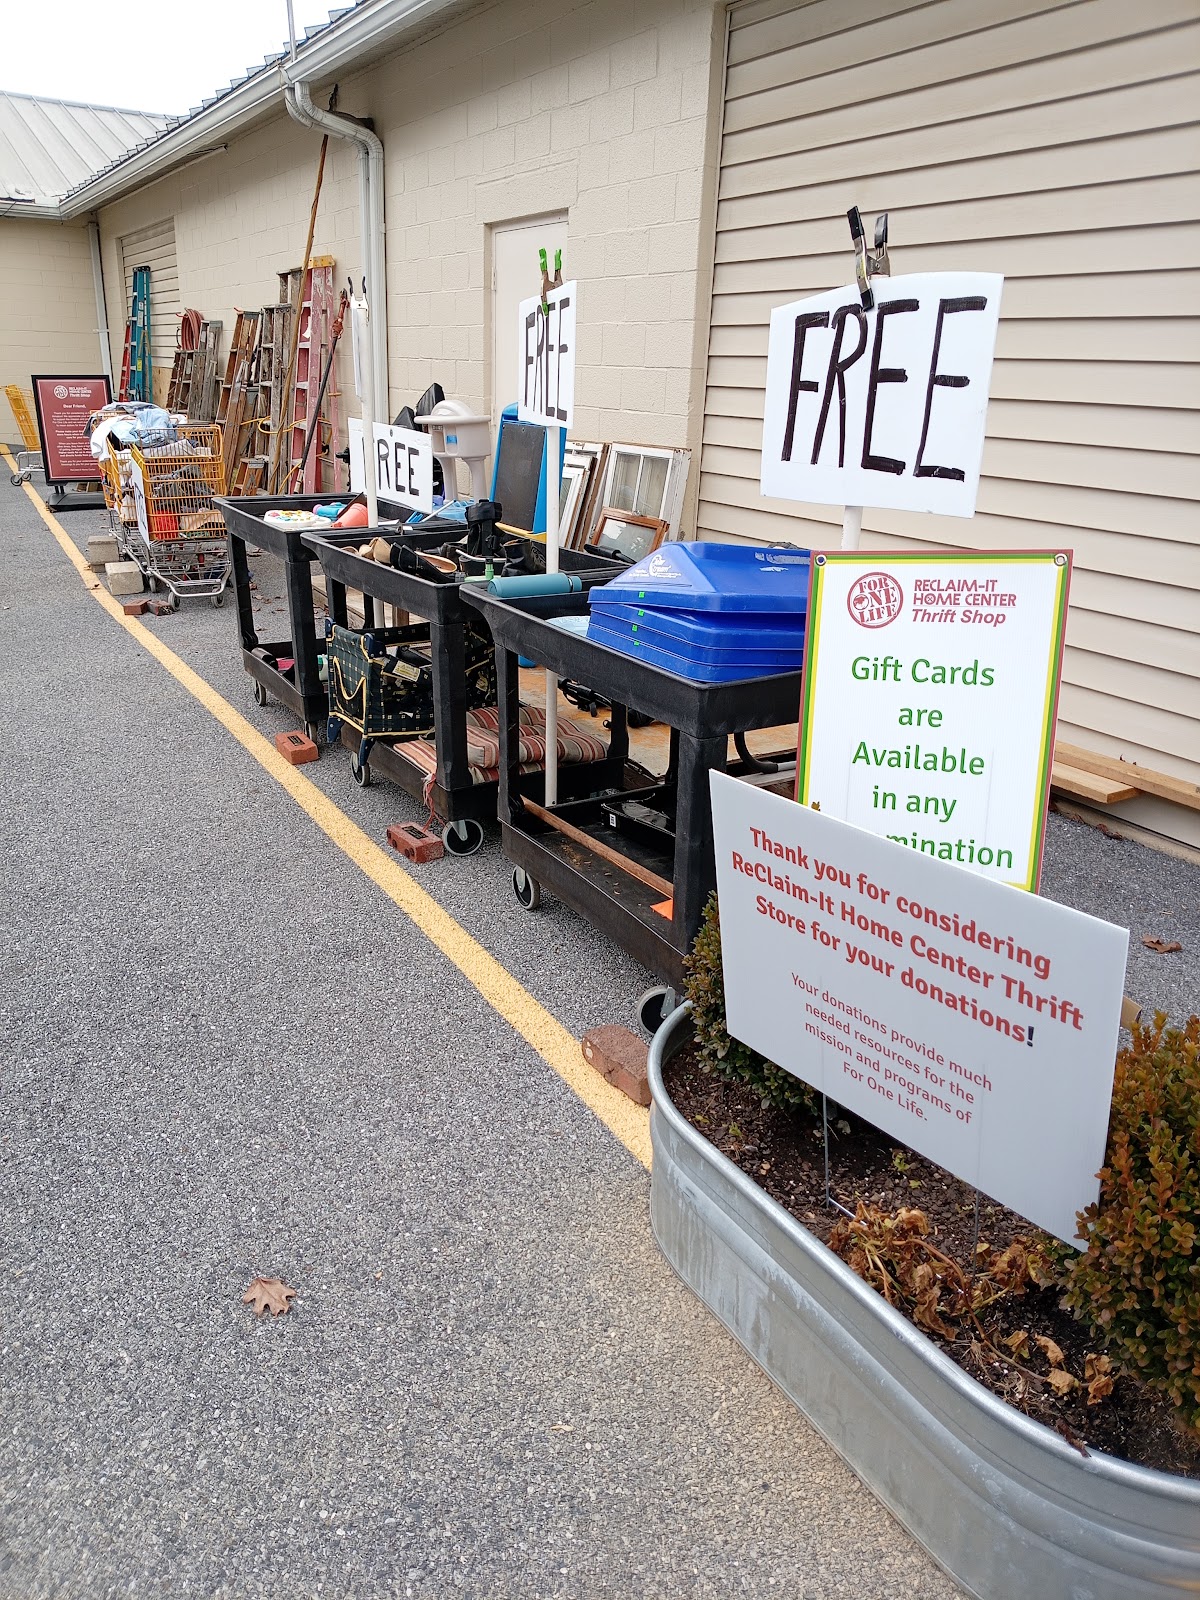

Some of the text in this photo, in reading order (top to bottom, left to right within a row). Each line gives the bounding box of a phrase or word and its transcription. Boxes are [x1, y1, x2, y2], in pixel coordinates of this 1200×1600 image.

[524, 297, 570, 421] FREE
[781, 296, 988, 482] FREE
[853, 586, 898, 610] ONE
[858, 576, 890, 594] FOR
[913, 579, 998, 592] RECLAIM-IT
[913, 593, 1017, 607] HOME CENTER
[858, 604, 898, 624] LIFE
[912, 608, 1006, 628] Thrift Shop
[851, 656, 995, 686] Gift Cards
[898, 708, 943, 728] are
[852, 741, 985, 775] Available
[873, 785, 957, 823] in any
[750, 827, 1051, 980] Thank you for considering
[732, 850, 1084, 1031] ReClaim-It Home Center Thrift
[756, 895, 1034, 1047] Store for your donations!
[791, 972, 992, 1091] Your donations provide much
[805, 1002, 974, 1104] needed resources for the
[805, 1022, 973, 1124] mission and programs of
[843, 1061, 928, 1121] For One Life.
